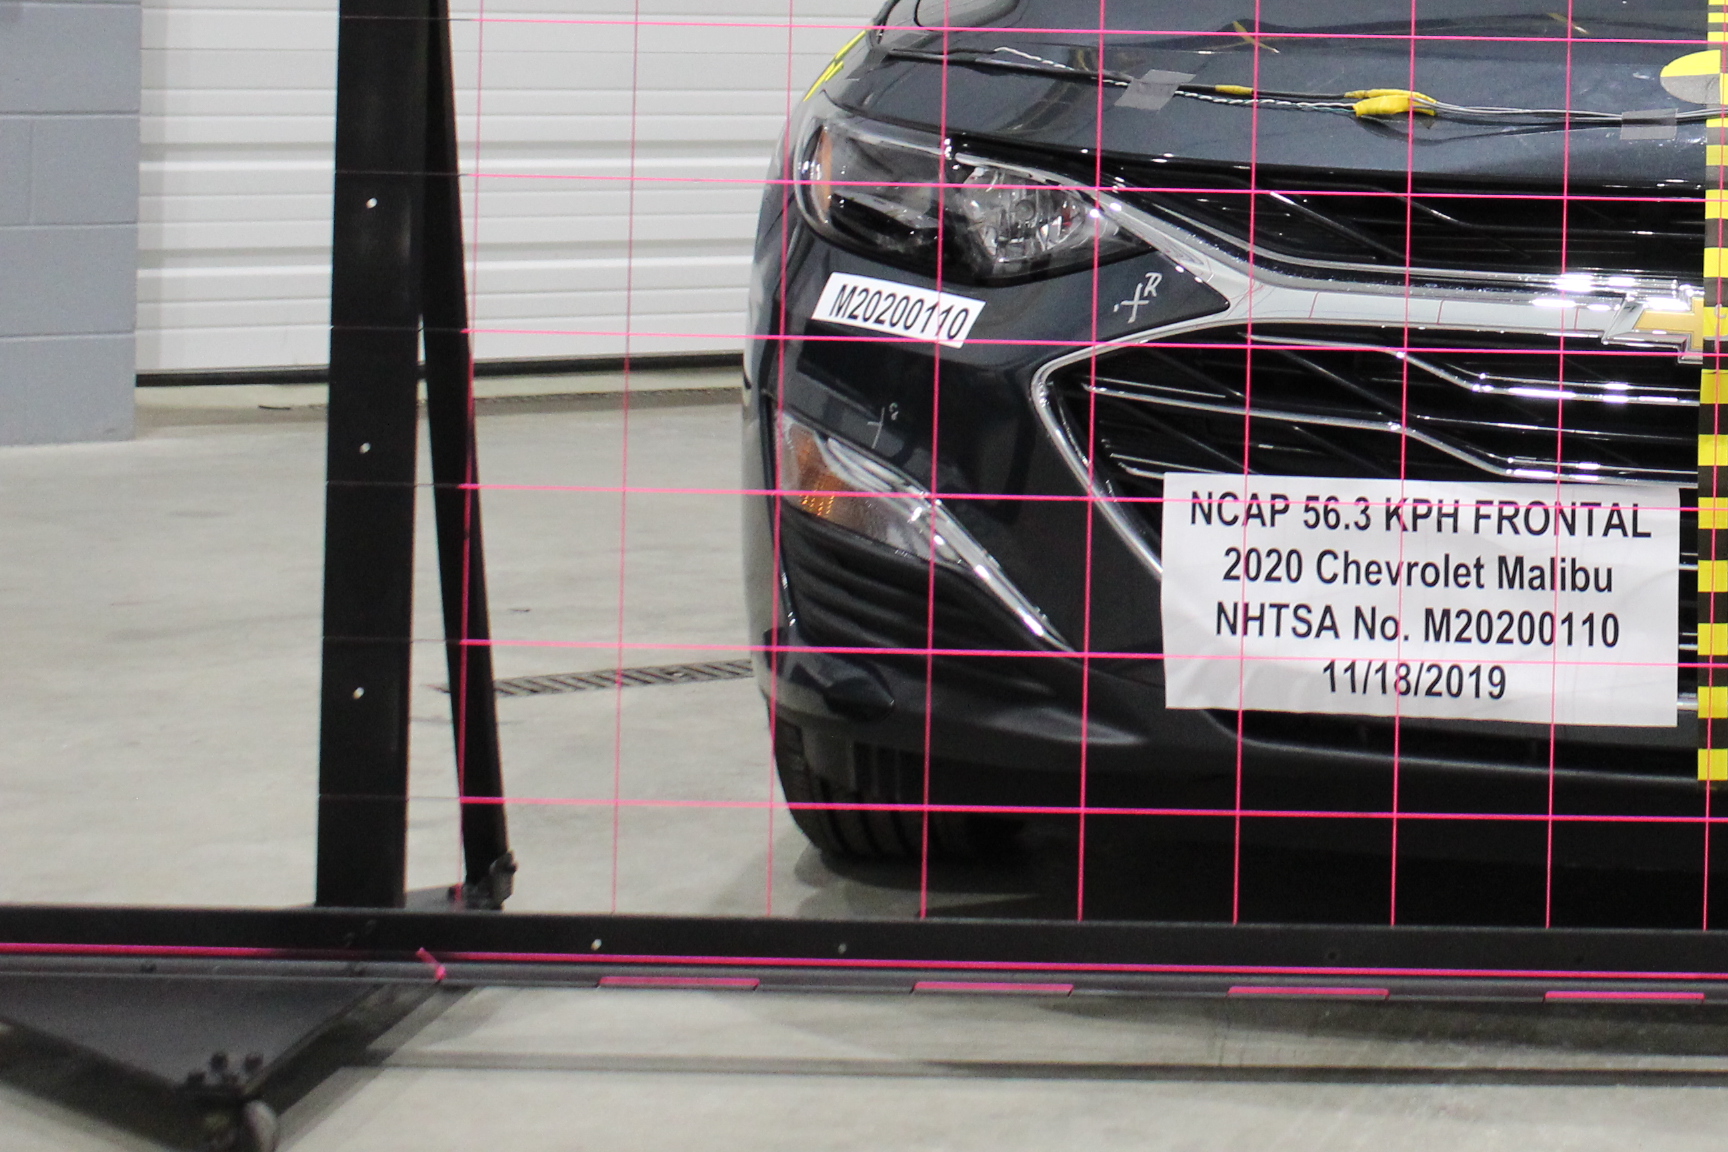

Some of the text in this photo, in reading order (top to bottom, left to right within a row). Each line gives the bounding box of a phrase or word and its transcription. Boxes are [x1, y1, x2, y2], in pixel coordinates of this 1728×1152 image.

[828, 283, 970, 341] M20200110
[1189, 490, 1652, 538] NCAP 56.3 KPH FRONTAL
[1223, 546, 1613, 593] 2020 Chevrolet Malibu
[1216, 601, 1620, 648] NHTSA No. M20200110
[1322, 659, 1507, 699] 11/18/2019
